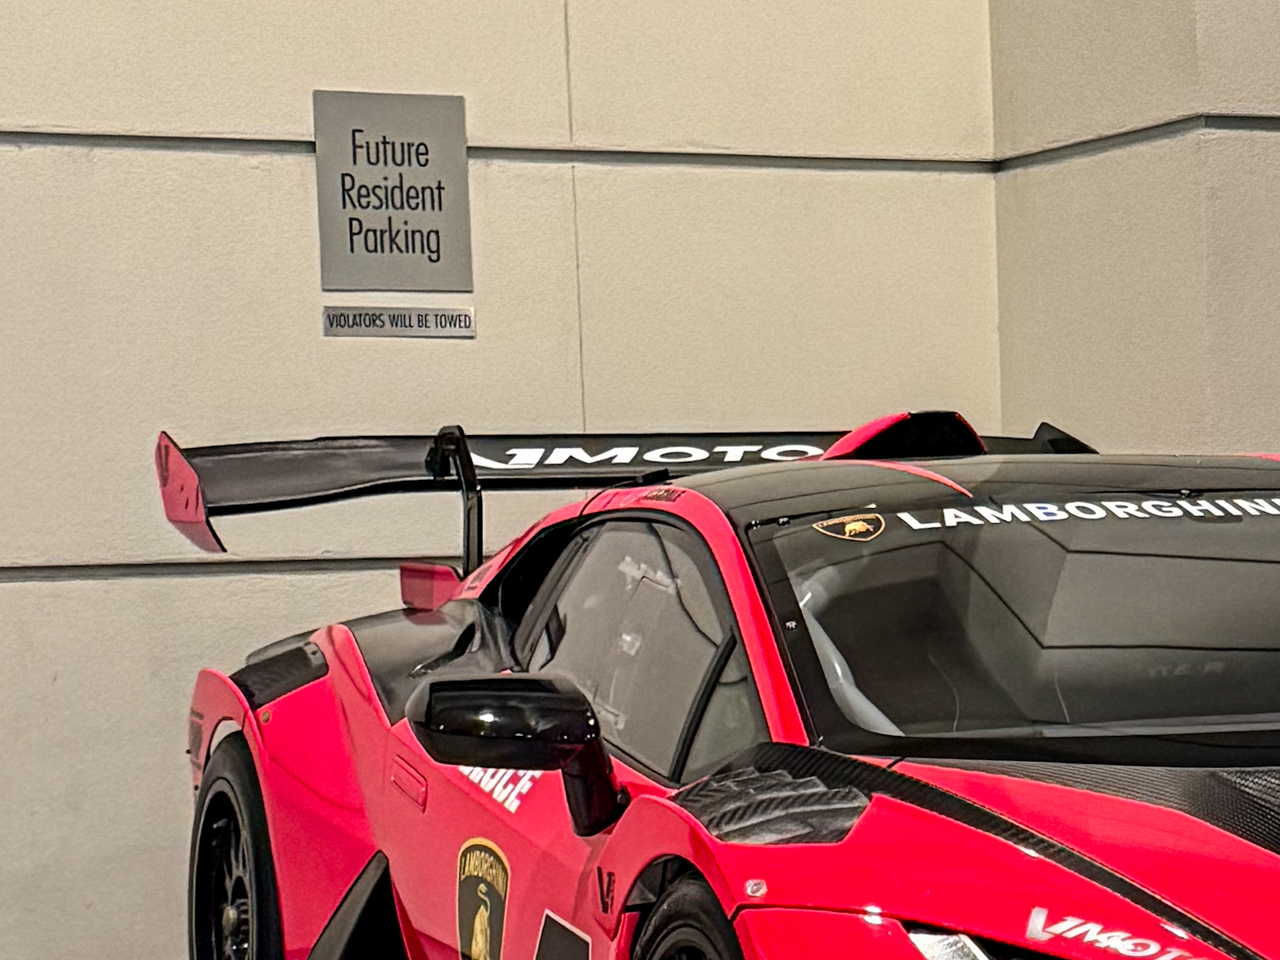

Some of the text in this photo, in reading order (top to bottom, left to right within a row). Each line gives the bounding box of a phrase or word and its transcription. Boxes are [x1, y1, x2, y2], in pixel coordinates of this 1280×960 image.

[351, 129, 429, 167] Future
[341, 172, 445, 212] Resident
[348, 216, 441, 263] Parking
[327, 312, 472, 329] VIOLATORS WILL BE TOWED
